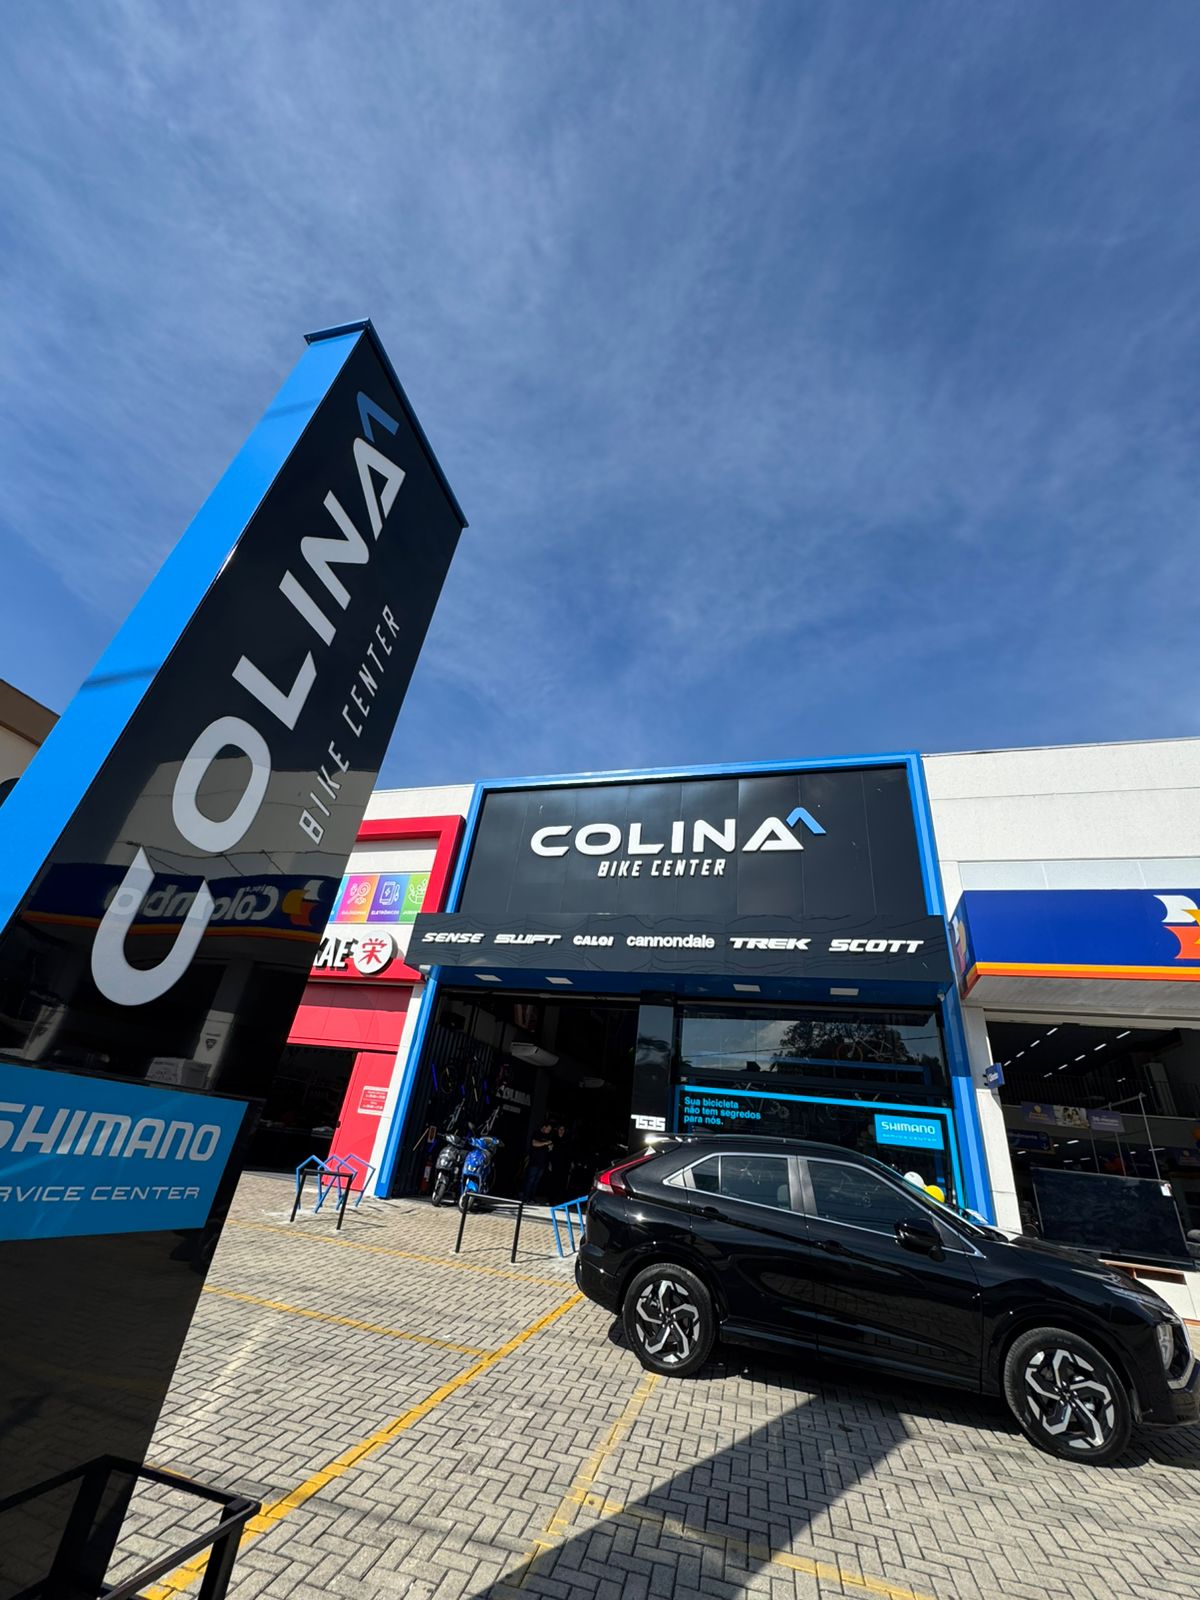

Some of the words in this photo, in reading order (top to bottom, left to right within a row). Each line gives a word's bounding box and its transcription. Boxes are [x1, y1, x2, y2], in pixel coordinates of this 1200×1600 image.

[92, 437, 406, 1006] COLINA
[299, 741, 351, 846] BIKE
[341, 604, 401, 738] CENTER
[530, 816, 804, 857] COLINA
[597, 859, 643, 877] BIKE
[650, 858, 726, 877] CENTER
[421, 932, 485, 944] SENSE
[494, 933, 562, 945] SWIFT
[573, 935, 615, 947] CALOI
[626, 934, 716, 950] cannondale
[729, 937, 812, 951] TREK
[828, 938, 925, 954] SCOTT
[684, 1096, 701, 1107] Sua
[702, 1097, 739, 1110] bicicleta
[683, 1115, 703, 1125] para
[705, 1114, 724, 1126] nós.
[684, 1105, 701, 1115] não
[702, 1107, 719, 1116] tem
[720, 1109, 762, 1121] segredos
[881, 1121, 936, 1135] SHIMANO
[0, 1185, 86, 1202] RVICE
[90, 1185, 201, 1201] CENTER
